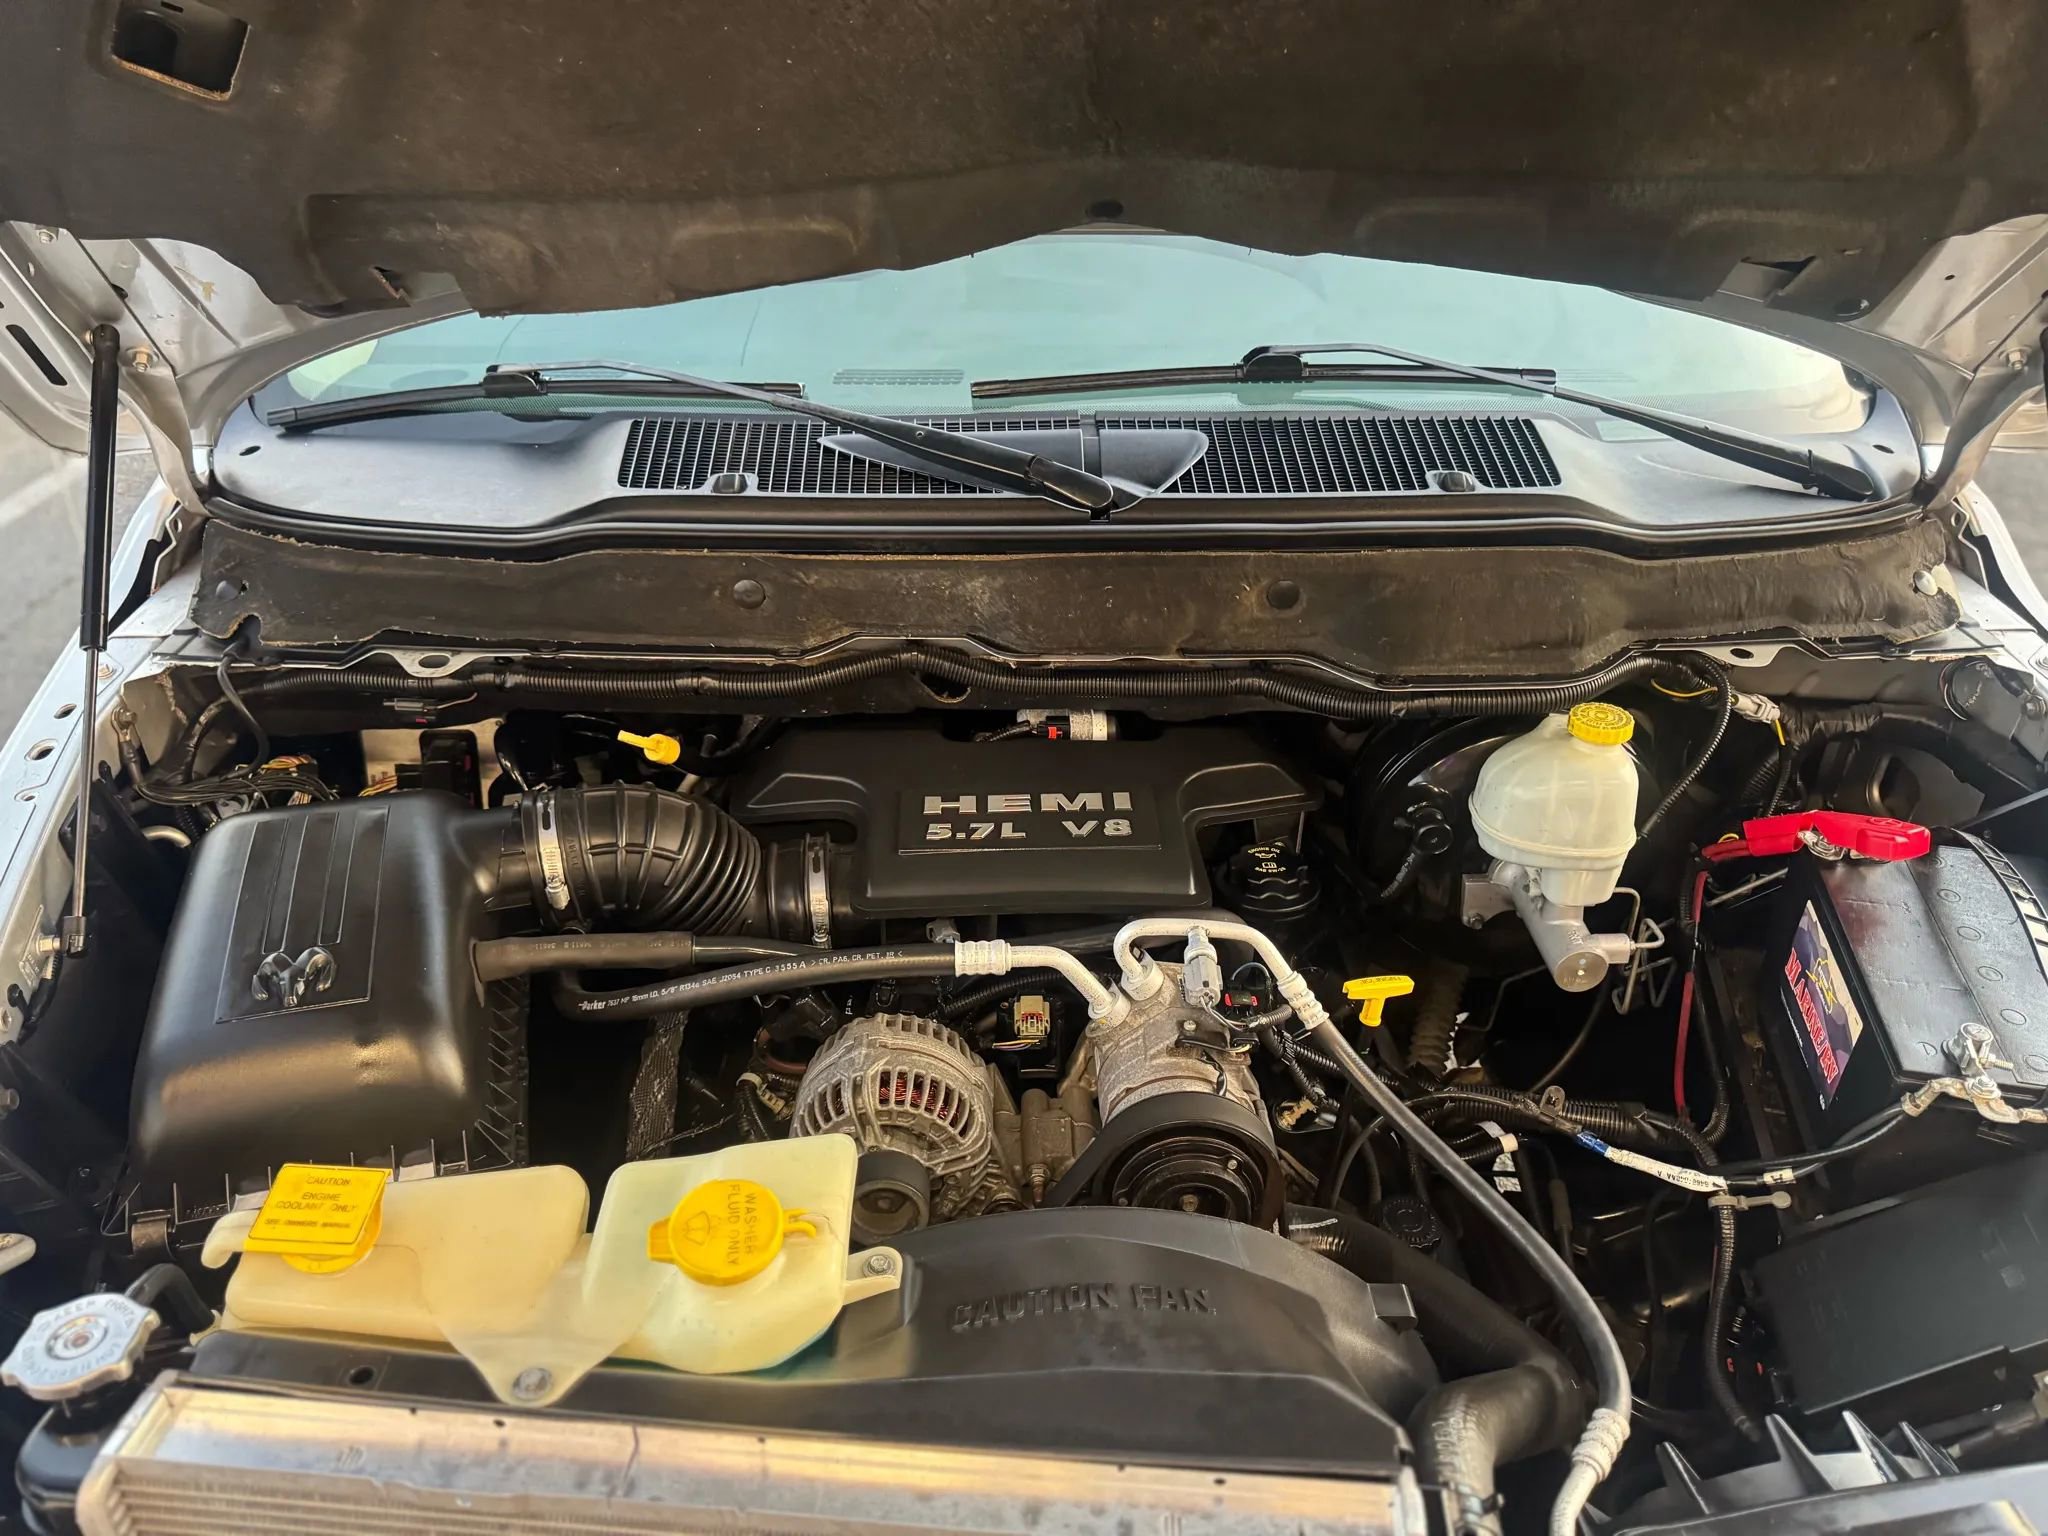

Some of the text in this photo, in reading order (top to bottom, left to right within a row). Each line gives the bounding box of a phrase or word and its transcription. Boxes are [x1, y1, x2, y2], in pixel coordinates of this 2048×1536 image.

[923, 792, 1132, 815] HEMI
[926, 818, 1132, 840] 5.7L V8
[702, 976, 717, 986] SAE
[744, 967, 764, 978] TYPE
[306, 1175, 351, 1186] CAUTION
[276, 1200, 358, 1213] COOLANT ONLY
[302, 1191, 342, 1202] ENGINE
[727, 1184, 740, 1266] FLUID ONLY
[744, 1192, 757, 1255] WASHER
[951, 1283, 1217, 1333] CAUTION FAN
